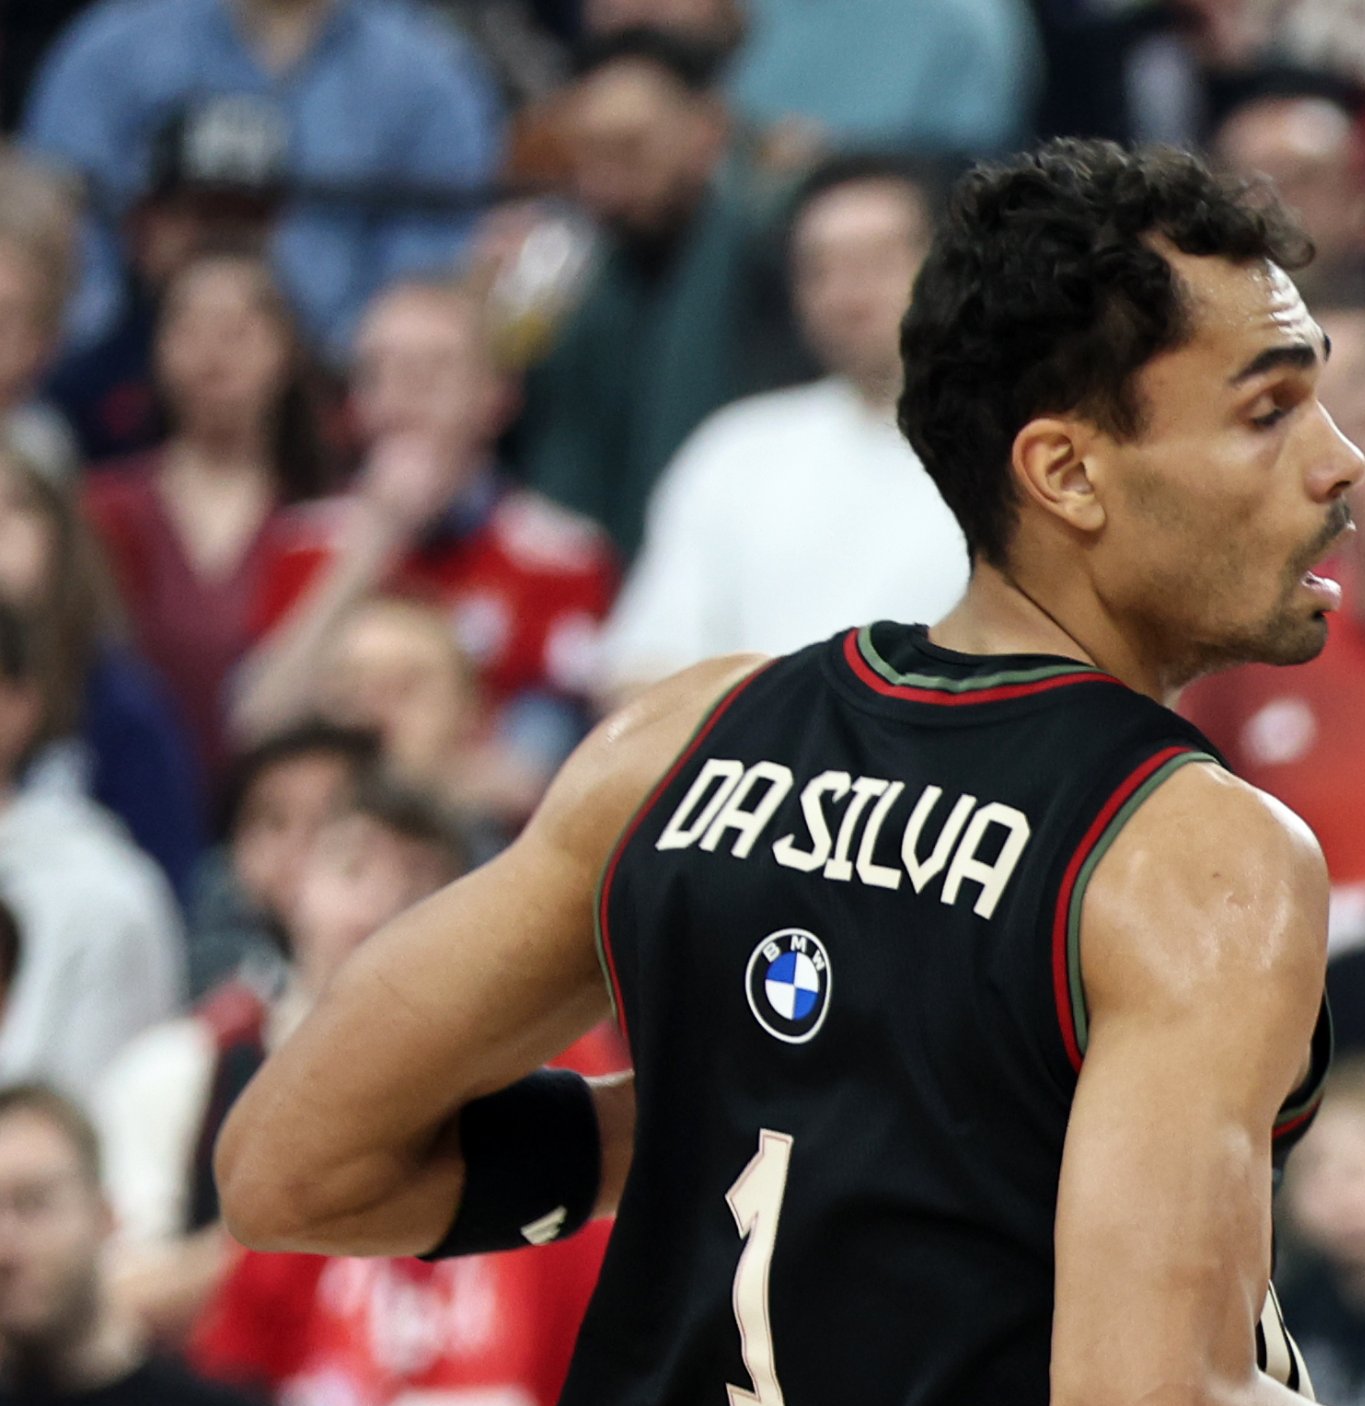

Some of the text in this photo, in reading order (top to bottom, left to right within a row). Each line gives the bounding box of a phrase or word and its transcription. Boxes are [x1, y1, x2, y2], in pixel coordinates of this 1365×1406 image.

[655, 758, 1030, 920] DA SILVA
[762, 934, 827, 972] BMW
